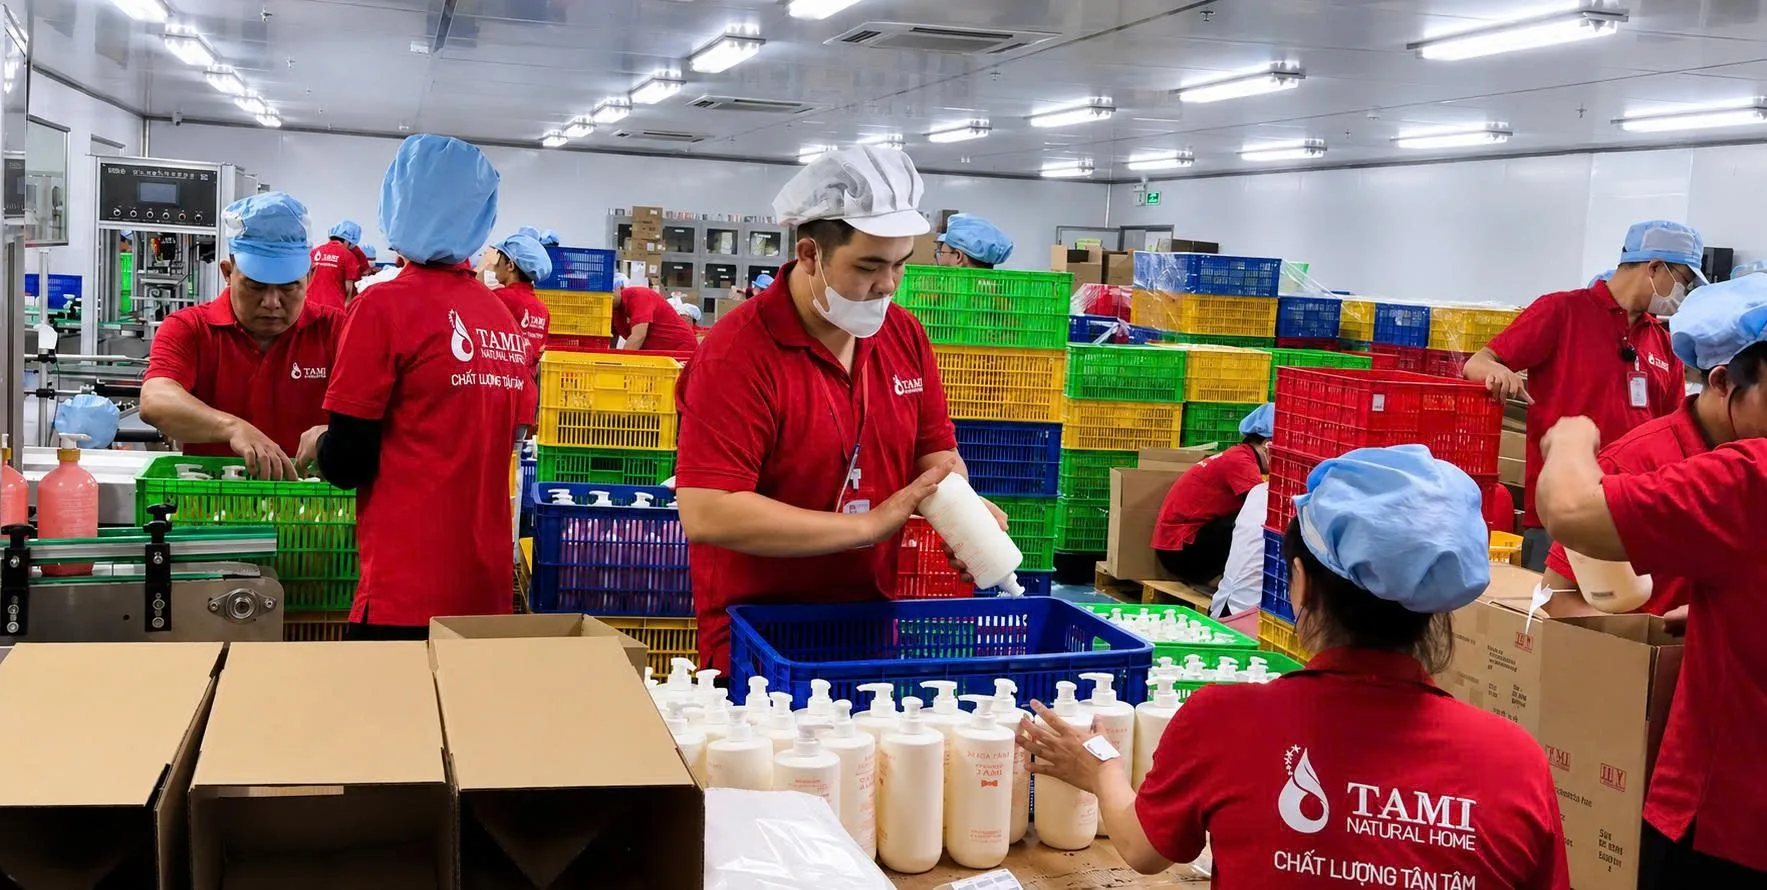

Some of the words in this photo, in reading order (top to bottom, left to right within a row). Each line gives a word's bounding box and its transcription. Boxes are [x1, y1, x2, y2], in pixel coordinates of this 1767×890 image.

[475, 328, 525, 353] TAMI
[451, 369, 476, 386] CHẤT
[901, 378, 923, 389] TAMI
[1346, 781, 1477, 832] TAMI
[1346, 816, 1426, 843] NATURAL
[1429, 828, 1477, 851] HOME
[1274, 849, 1326, 876] CHẤT
[1330, 858, 1397, 886] LƯỢNG
[1441, 870, 1476, 890] TÂM
